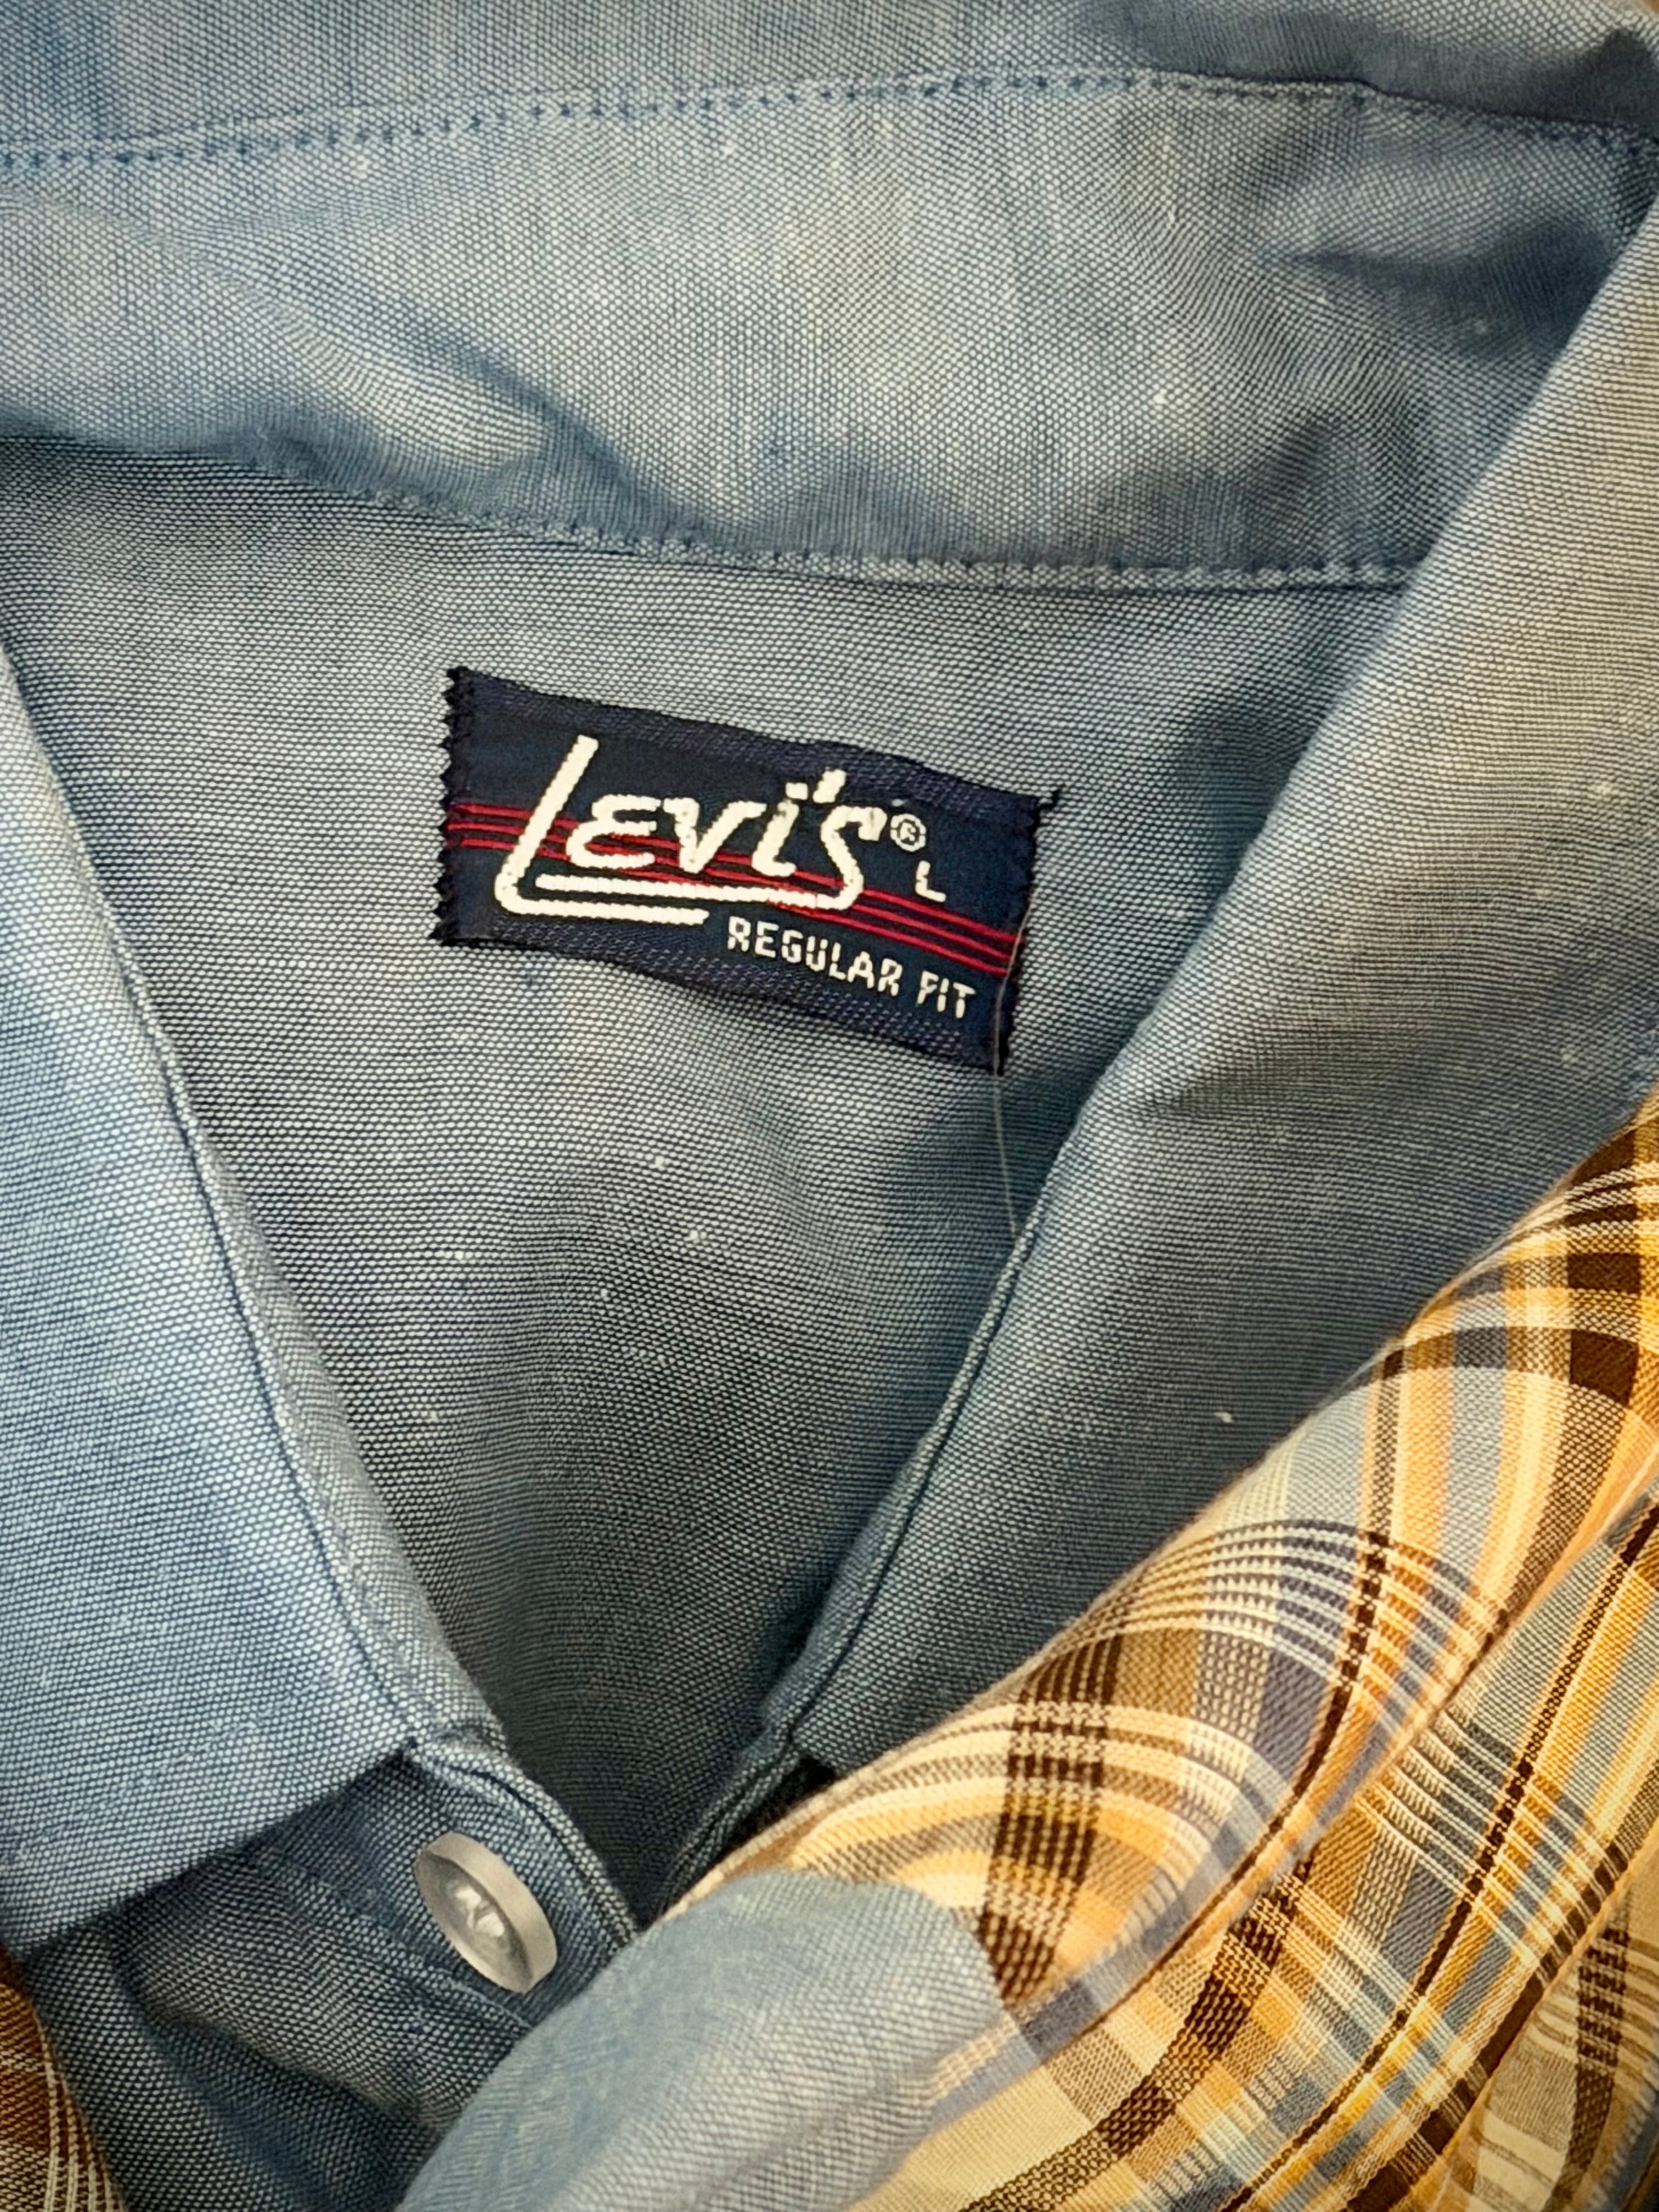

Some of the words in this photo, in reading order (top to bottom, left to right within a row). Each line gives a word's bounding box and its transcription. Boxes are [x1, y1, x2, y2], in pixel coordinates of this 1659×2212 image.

[915, 861, 947, 902] L
[727, 916, 904, 997] REGULAR
[917, 970, 975, 1019] FIT
